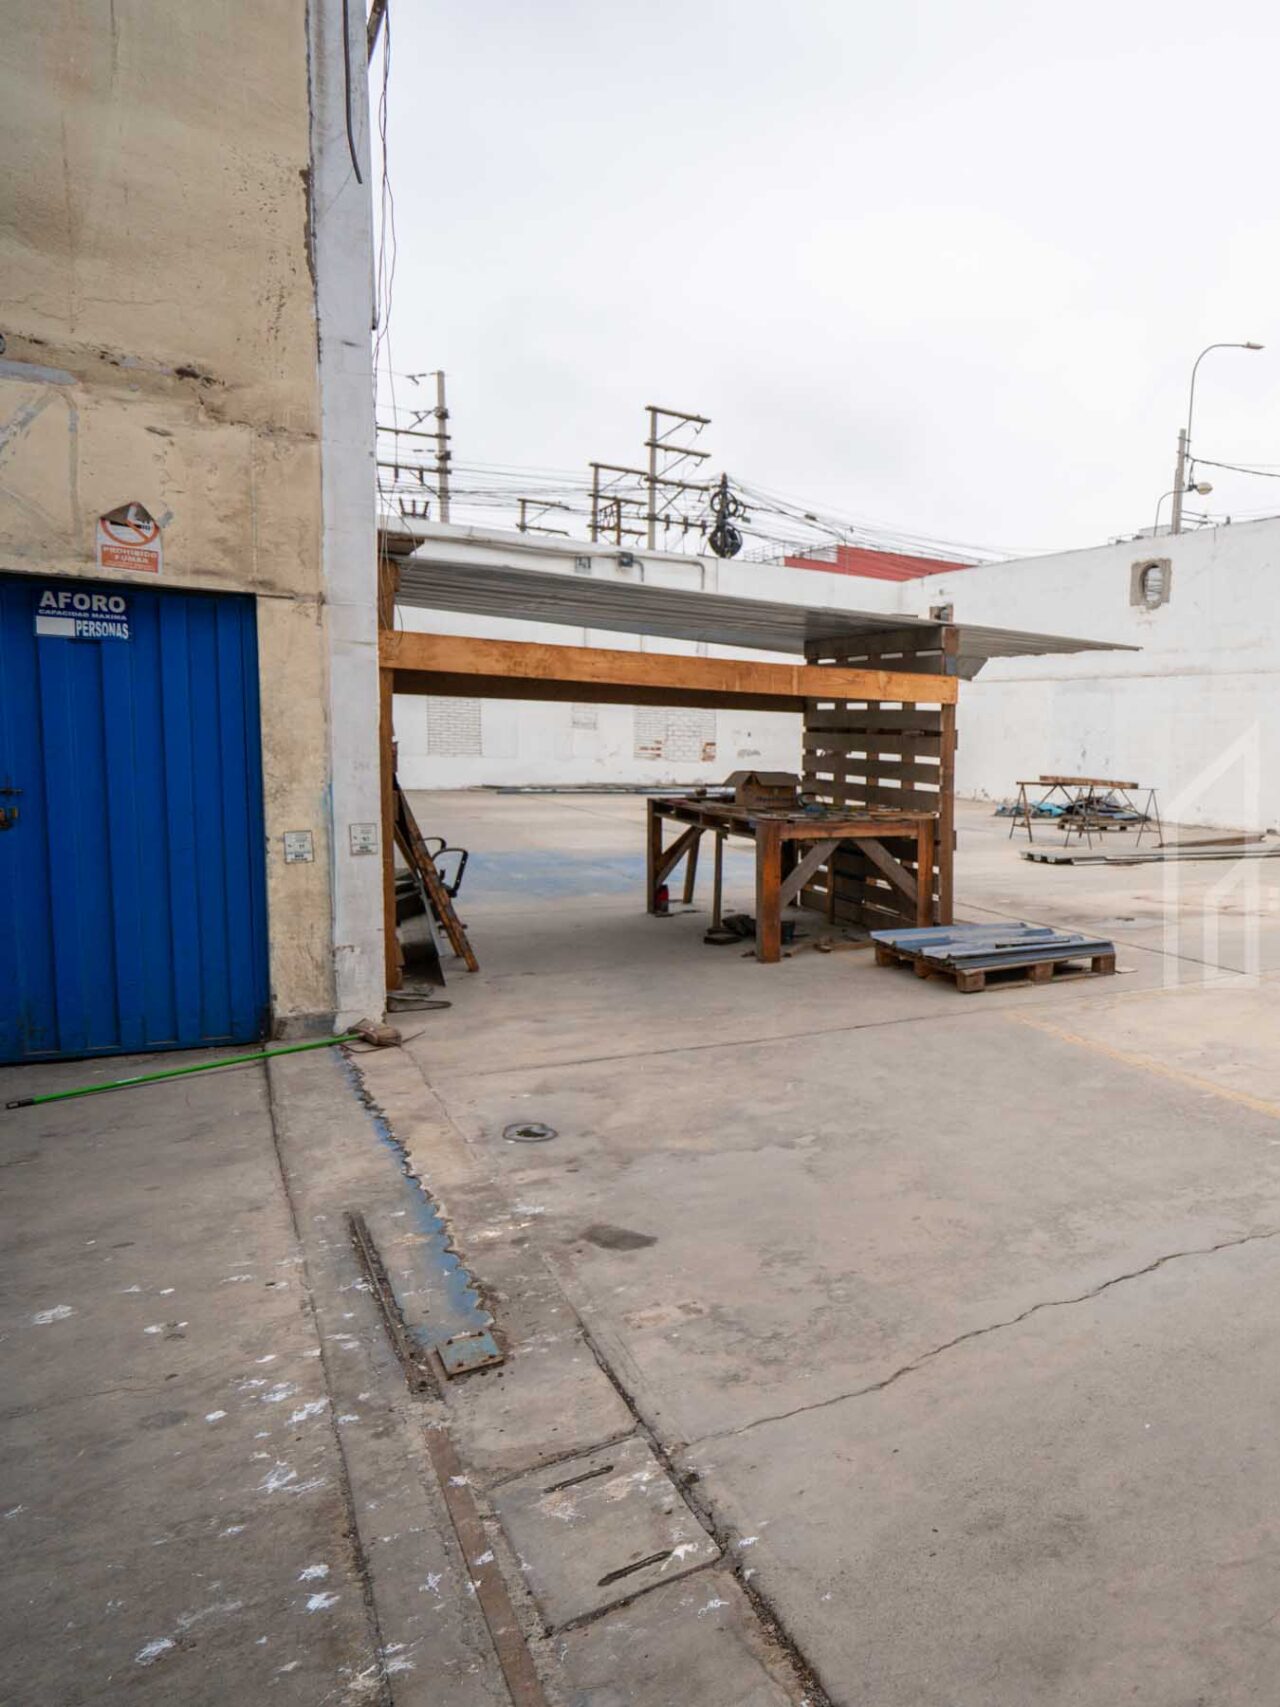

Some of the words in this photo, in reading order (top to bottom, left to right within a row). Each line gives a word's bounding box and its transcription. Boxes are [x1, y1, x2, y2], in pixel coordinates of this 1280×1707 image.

[40, 591, 126, 613] AFORO
[39, 609, 90, 618] CAPACIDAD
[92, 613, 128, 621] MAXIMA
[76, 620, 129, 639] PERSONAS
